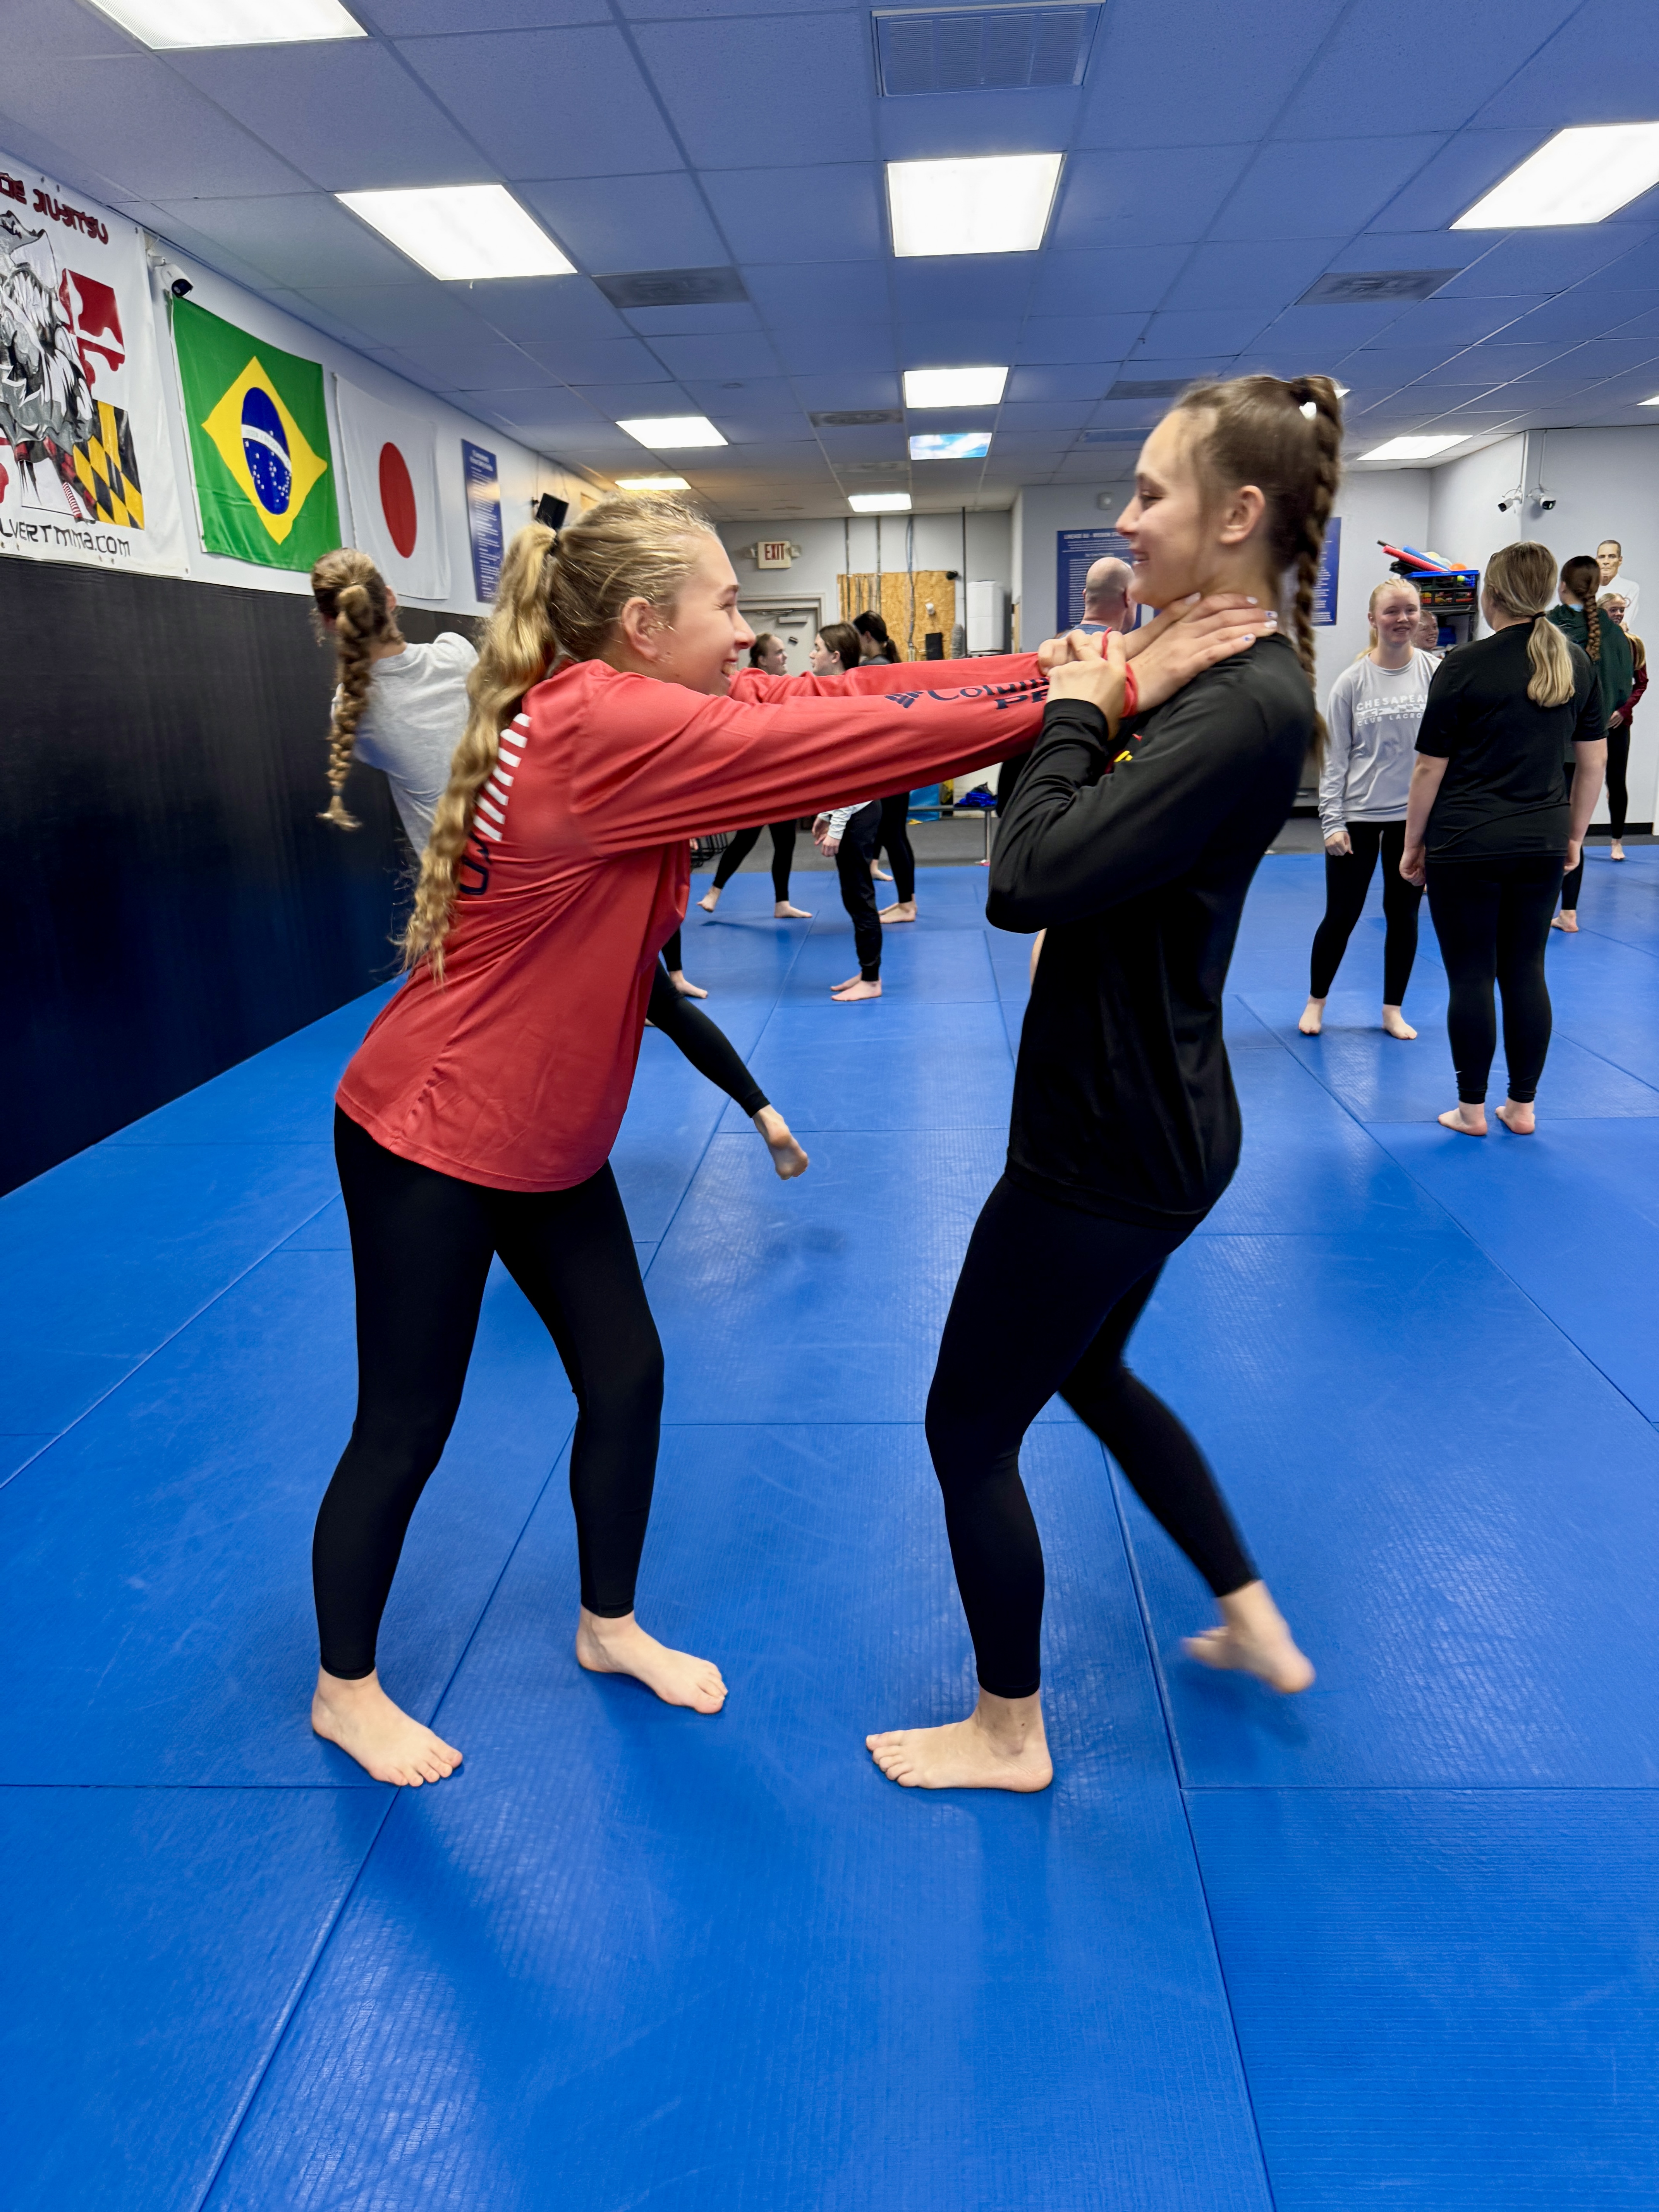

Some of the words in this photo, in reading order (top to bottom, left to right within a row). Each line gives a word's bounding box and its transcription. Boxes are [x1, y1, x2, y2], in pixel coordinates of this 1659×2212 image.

[33, 189, 108, 245] JIU-JITSU
[764, 543, 785, 560] EXIT
[1357, 716, 1382, 726] CLUB
